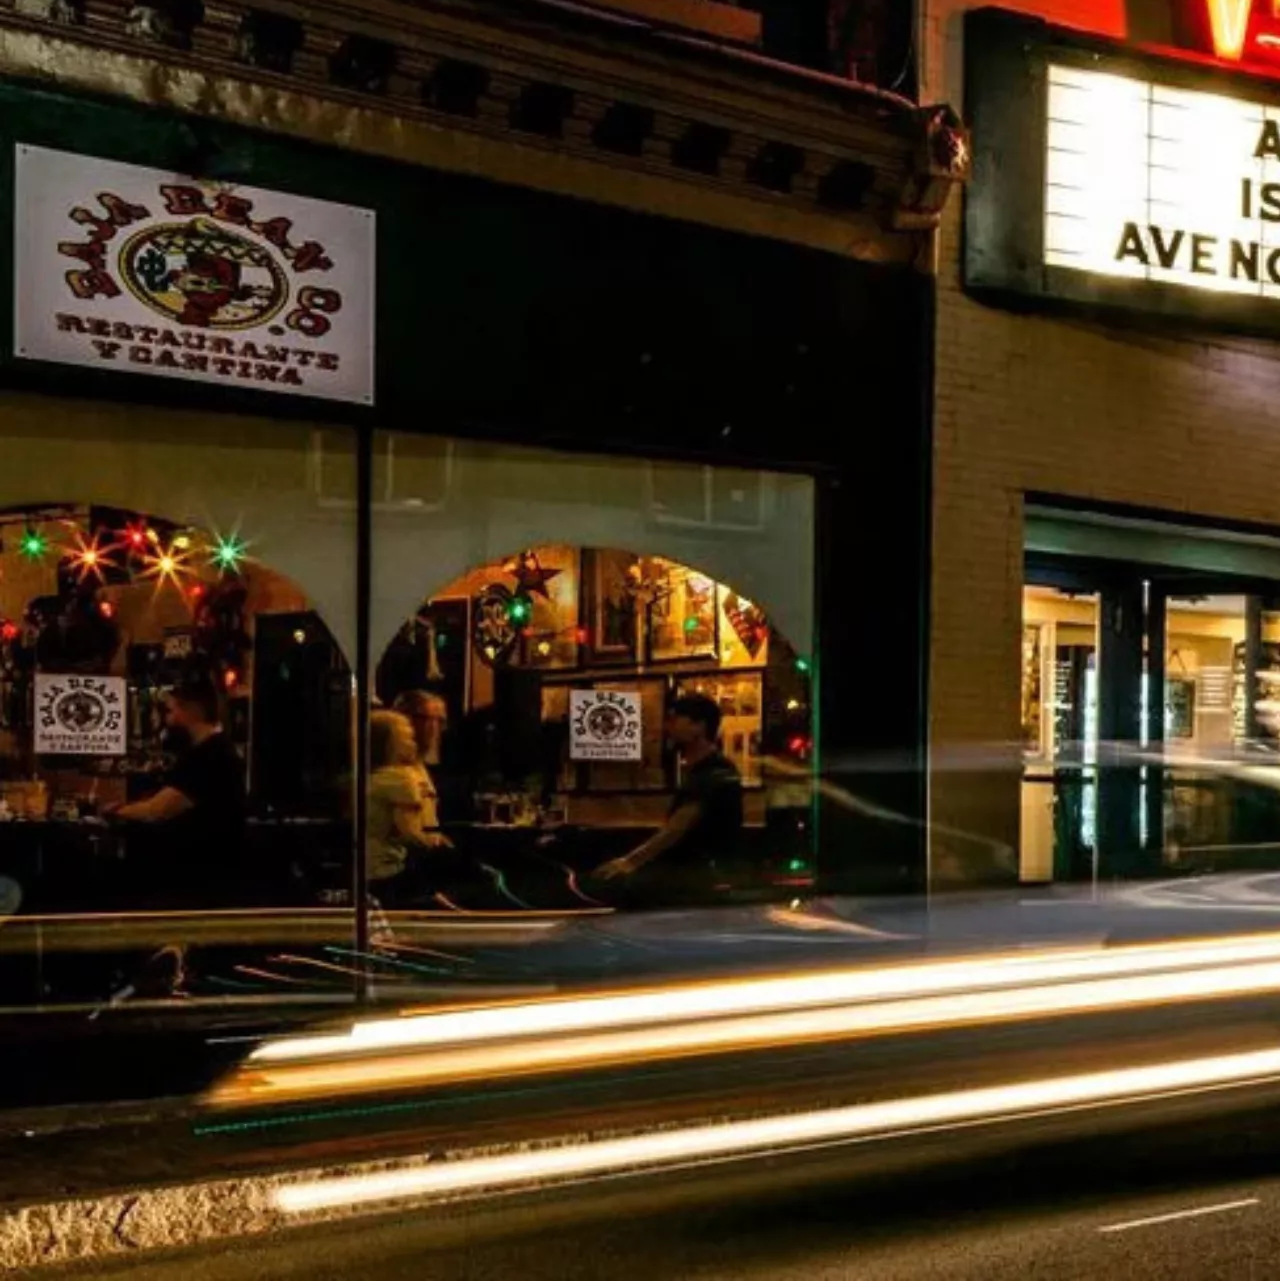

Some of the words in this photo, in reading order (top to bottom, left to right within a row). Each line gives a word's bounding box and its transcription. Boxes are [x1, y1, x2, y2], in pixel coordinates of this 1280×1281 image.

[57, 191, 151, 300] BAJA
[159, 183, 334, 273] BEAN
[55, 313, 340, 372] RESTAURANTE
[92, 339, 122, 361] Y
[128, 346, 303, 386] CANTINA
